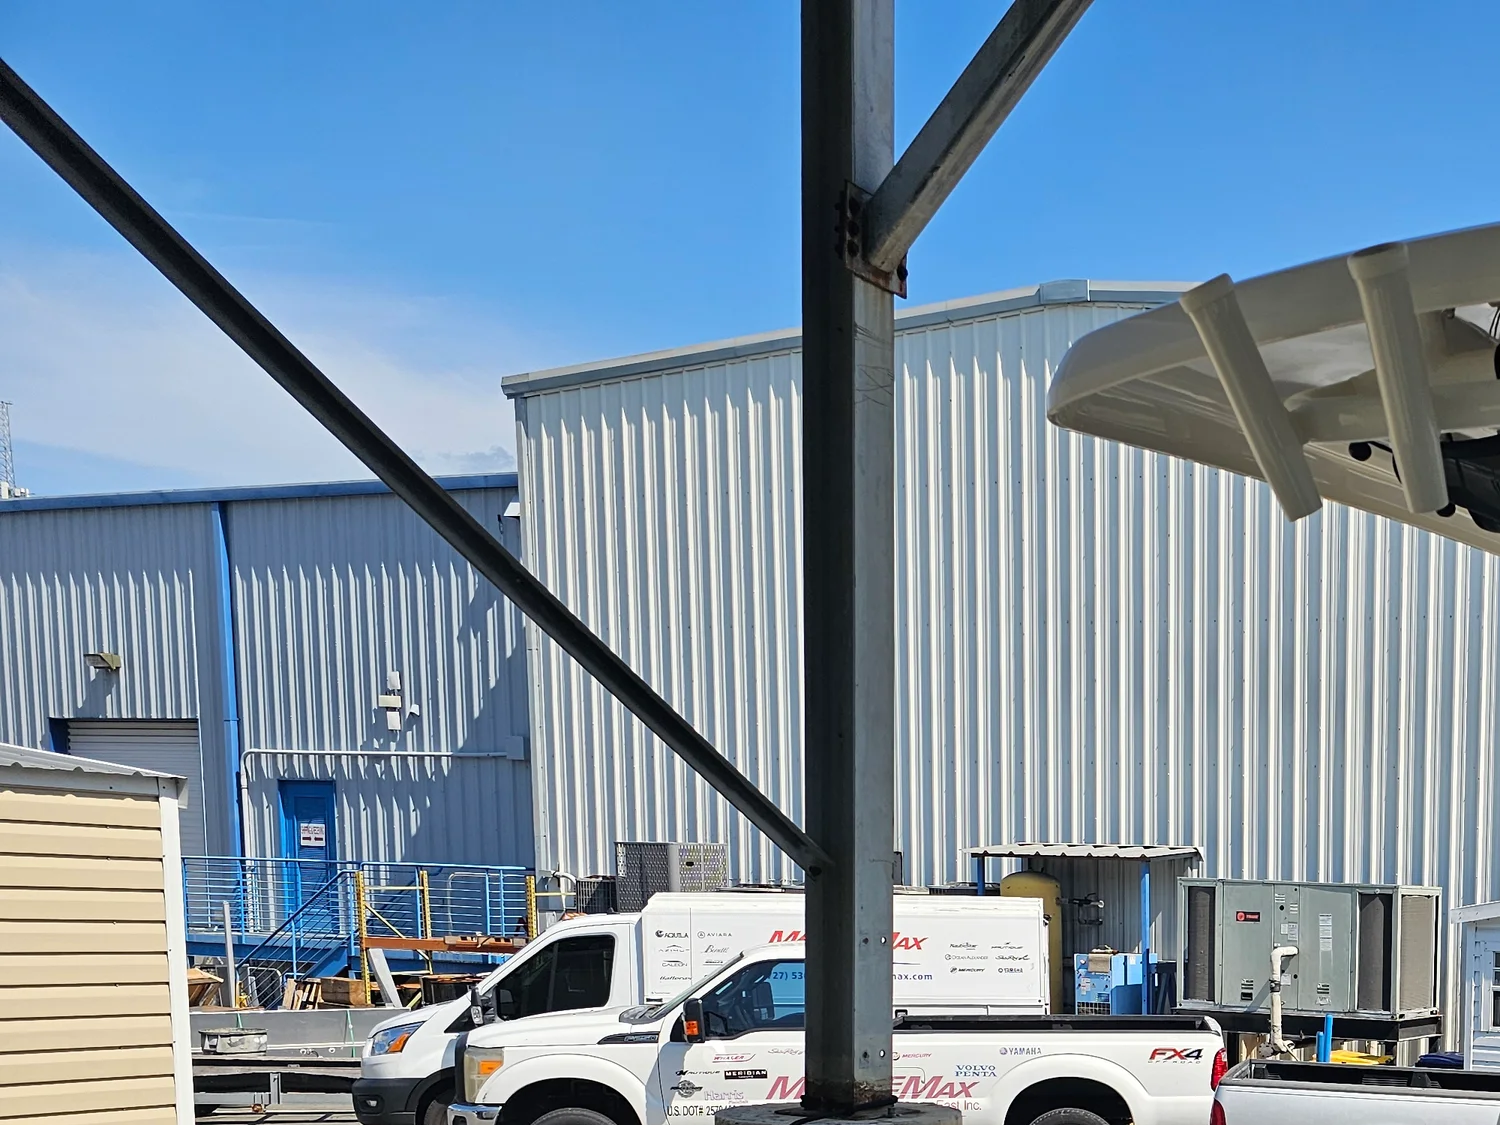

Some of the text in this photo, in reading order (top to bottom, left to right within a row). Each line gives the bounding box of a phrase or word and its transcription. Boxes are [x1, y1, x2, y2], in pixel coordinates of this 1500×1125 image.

[1008, 1047, 1042, 1056] YAMAHA
[1149, 1048, 1204, 1060] FX4
[964, 1100, 982, 1111] Inc.
